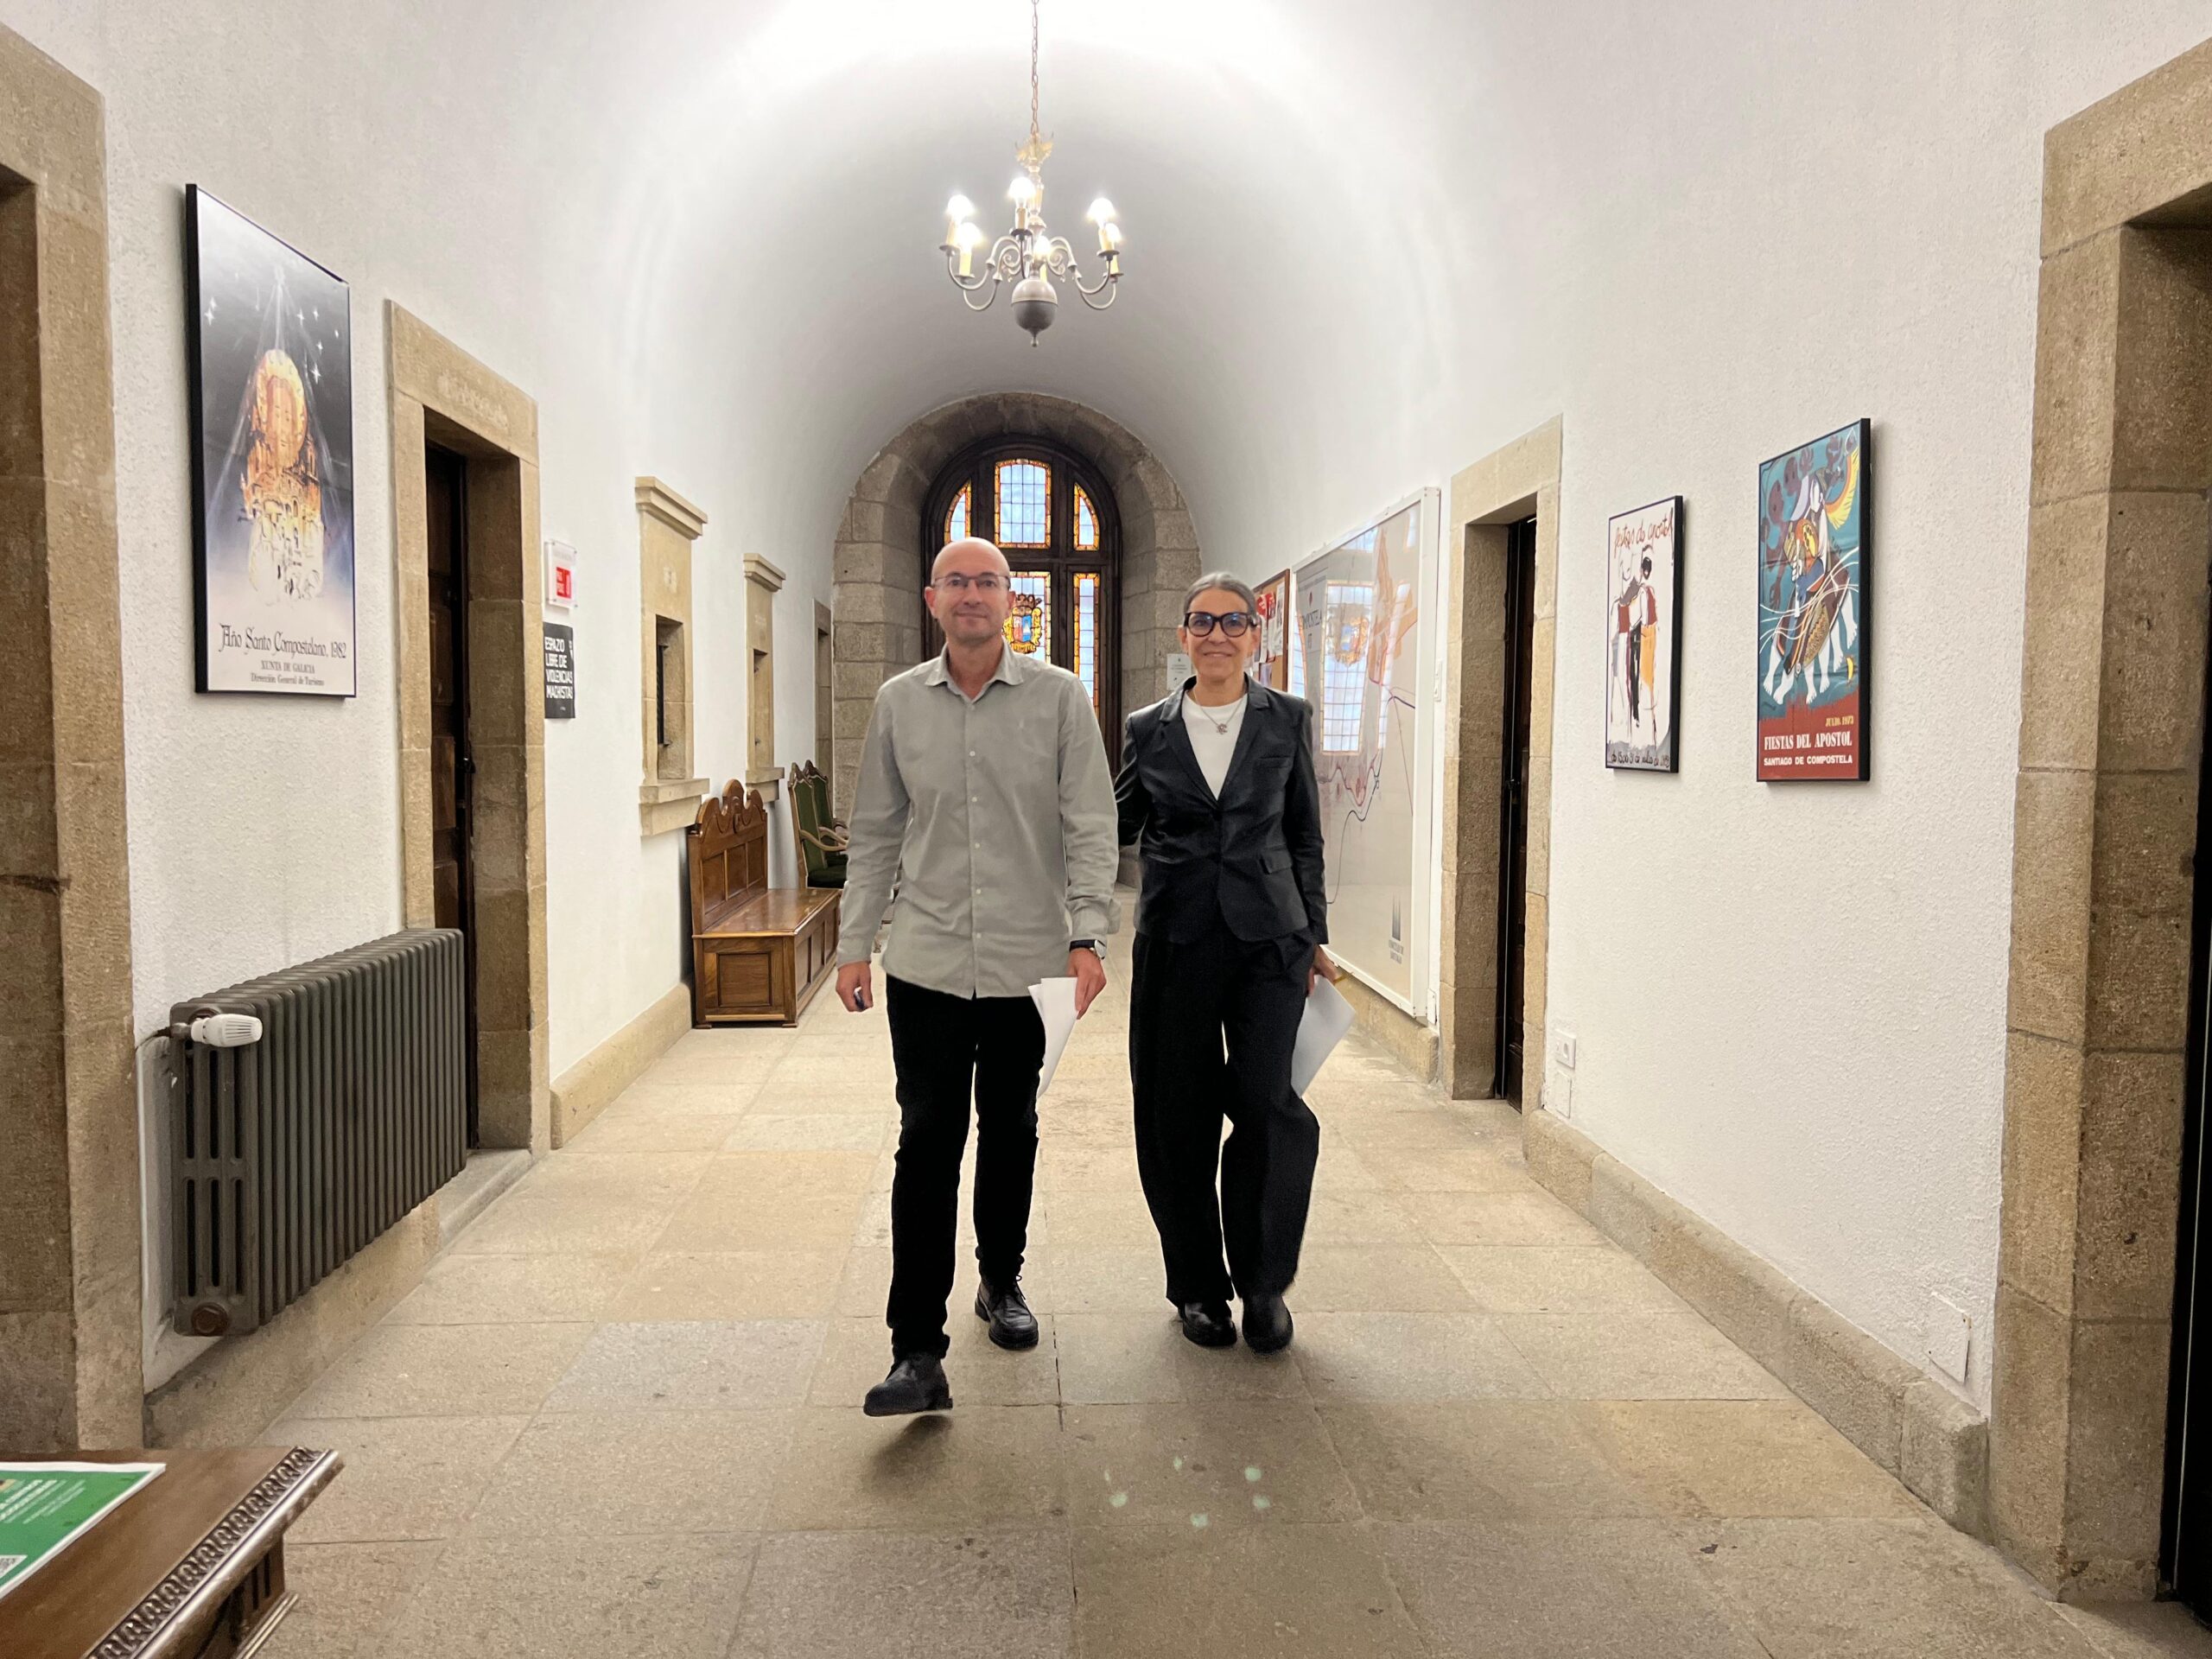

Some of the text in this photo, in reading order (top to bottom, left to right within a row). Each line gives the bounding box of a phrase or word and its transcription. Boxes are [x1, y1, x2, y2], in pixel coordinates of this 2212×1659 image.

[219, 623, 242, 652] Año
[245, 627, 271, 654] Santo
[261, 660, 315, 674] XUNTA DE GALICIA
[558, 654, 568, 668] DE
[298, 676, 305, 684] de
[1764, 731, 1852, 750] FIESTAS DEL APOSTOL
[1764, 754, 1853, 766] SANTIAGO DE COMPOSTELA
